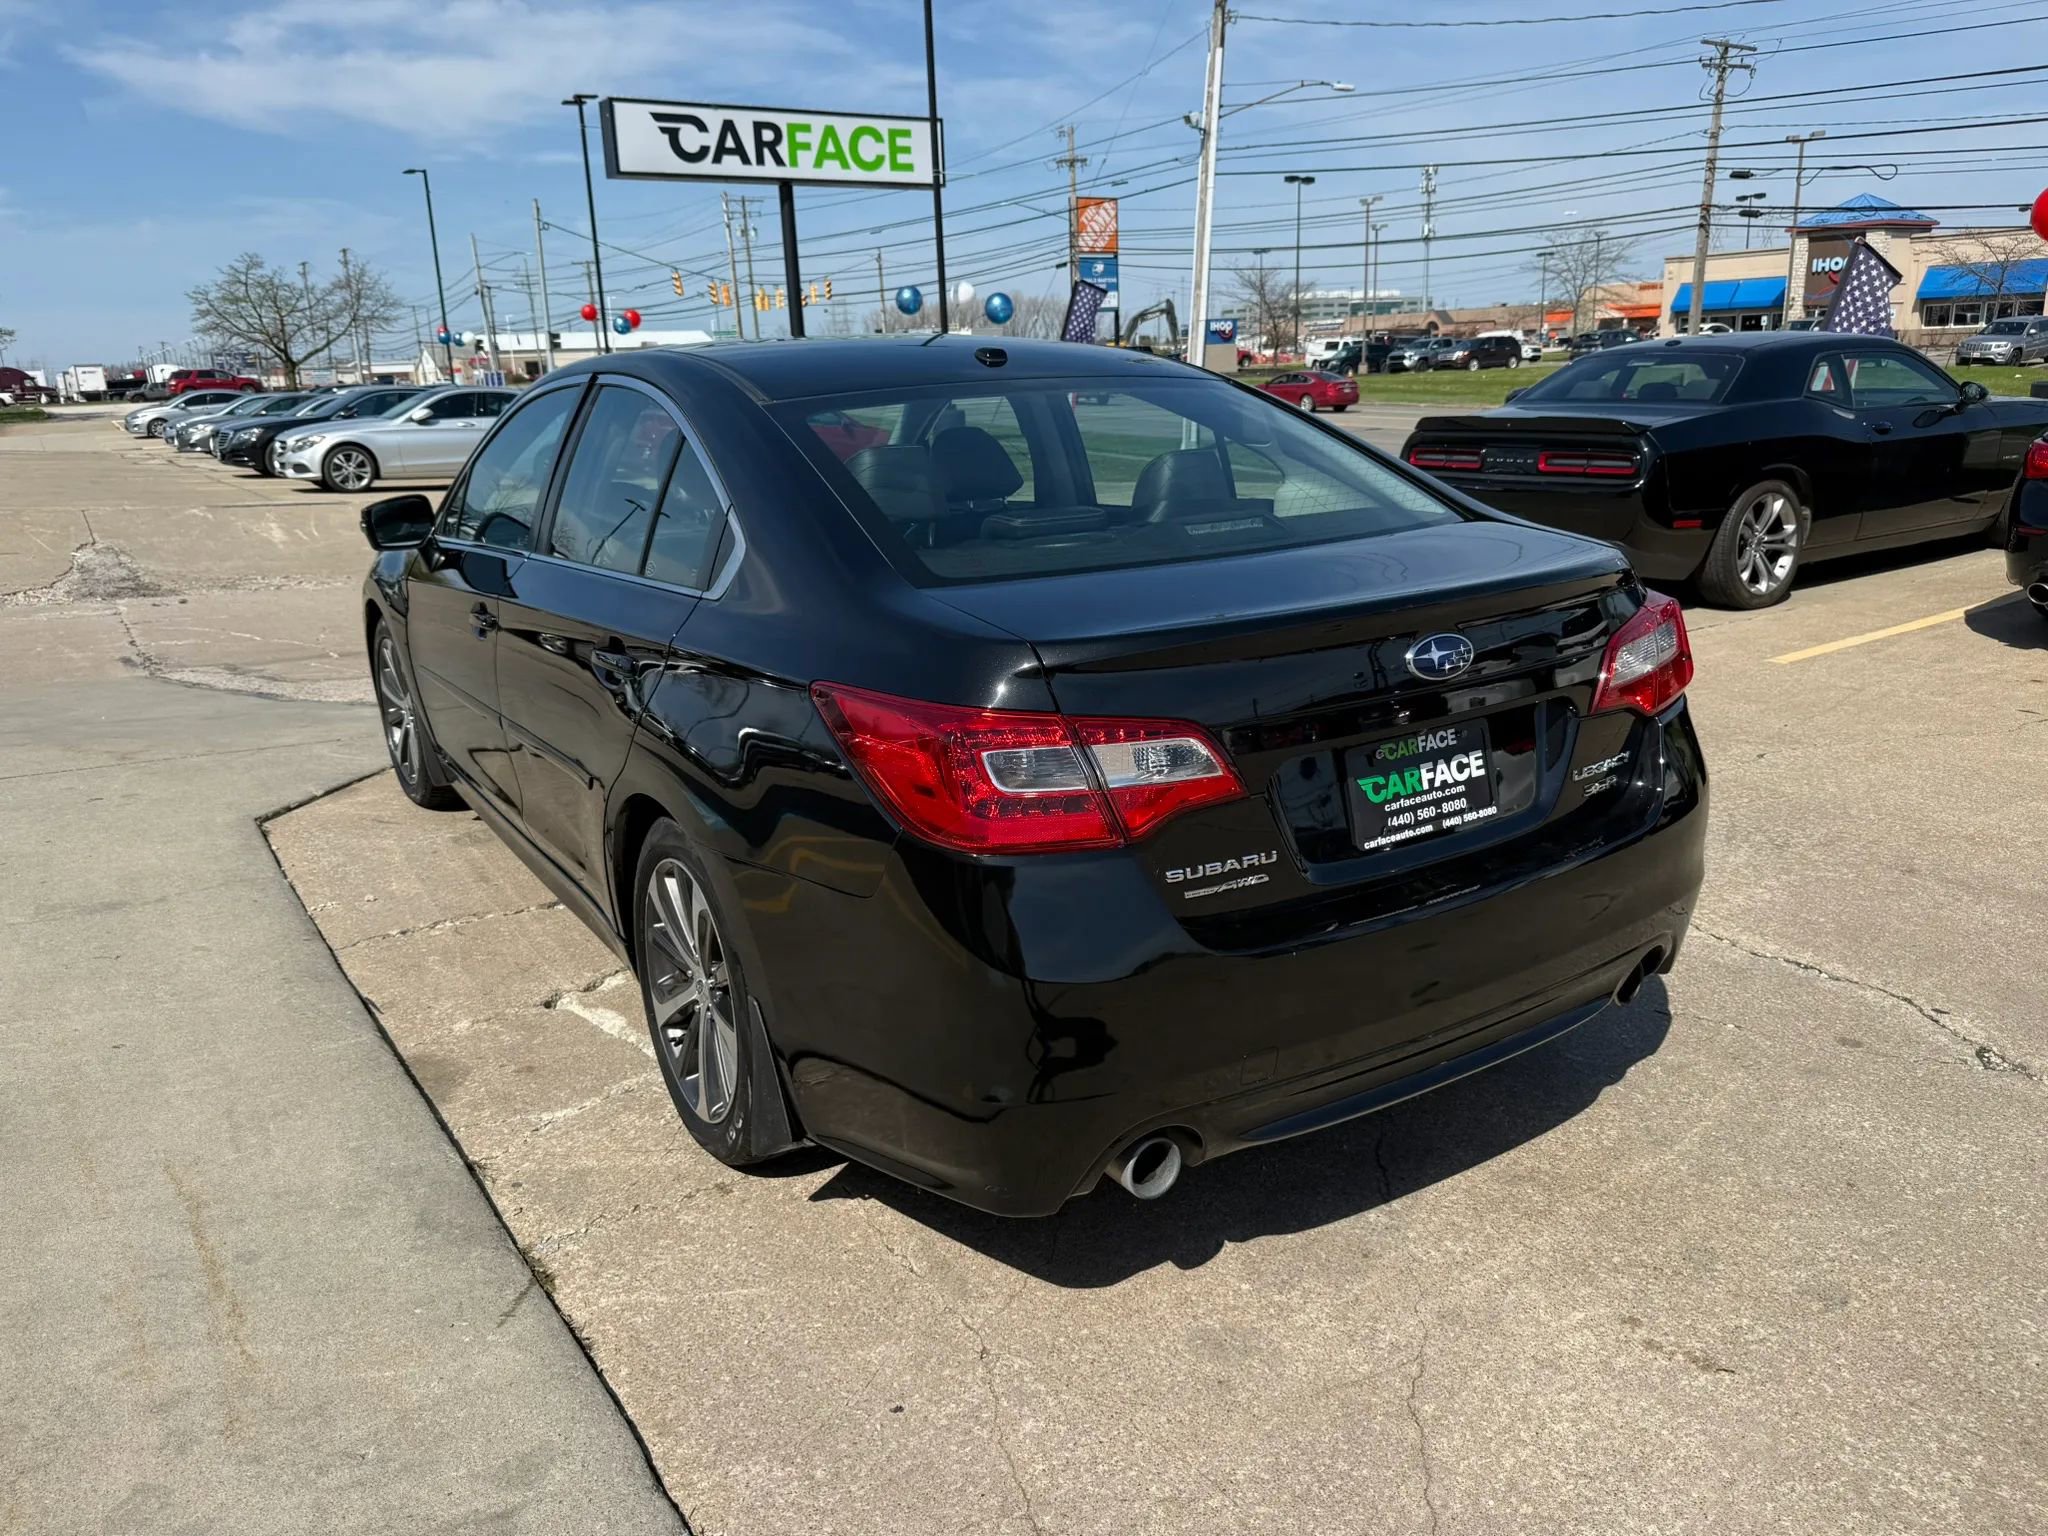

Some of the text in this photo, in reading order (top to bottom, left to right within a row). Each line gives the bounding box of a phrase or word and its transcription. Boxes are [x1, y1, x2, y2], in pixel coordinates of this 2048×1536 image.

[649, 112, 914, 172] CARFACE
[1357, 750, 1485, 804] CARFACE
[1385, 784, 1466, 812] carfaceauto.com
[1387, 811, 1415, 827] (440)
[1364, 824, 1433, 849] carfaceauto.com
[1165, 850, 1277, 883] SUBARU
